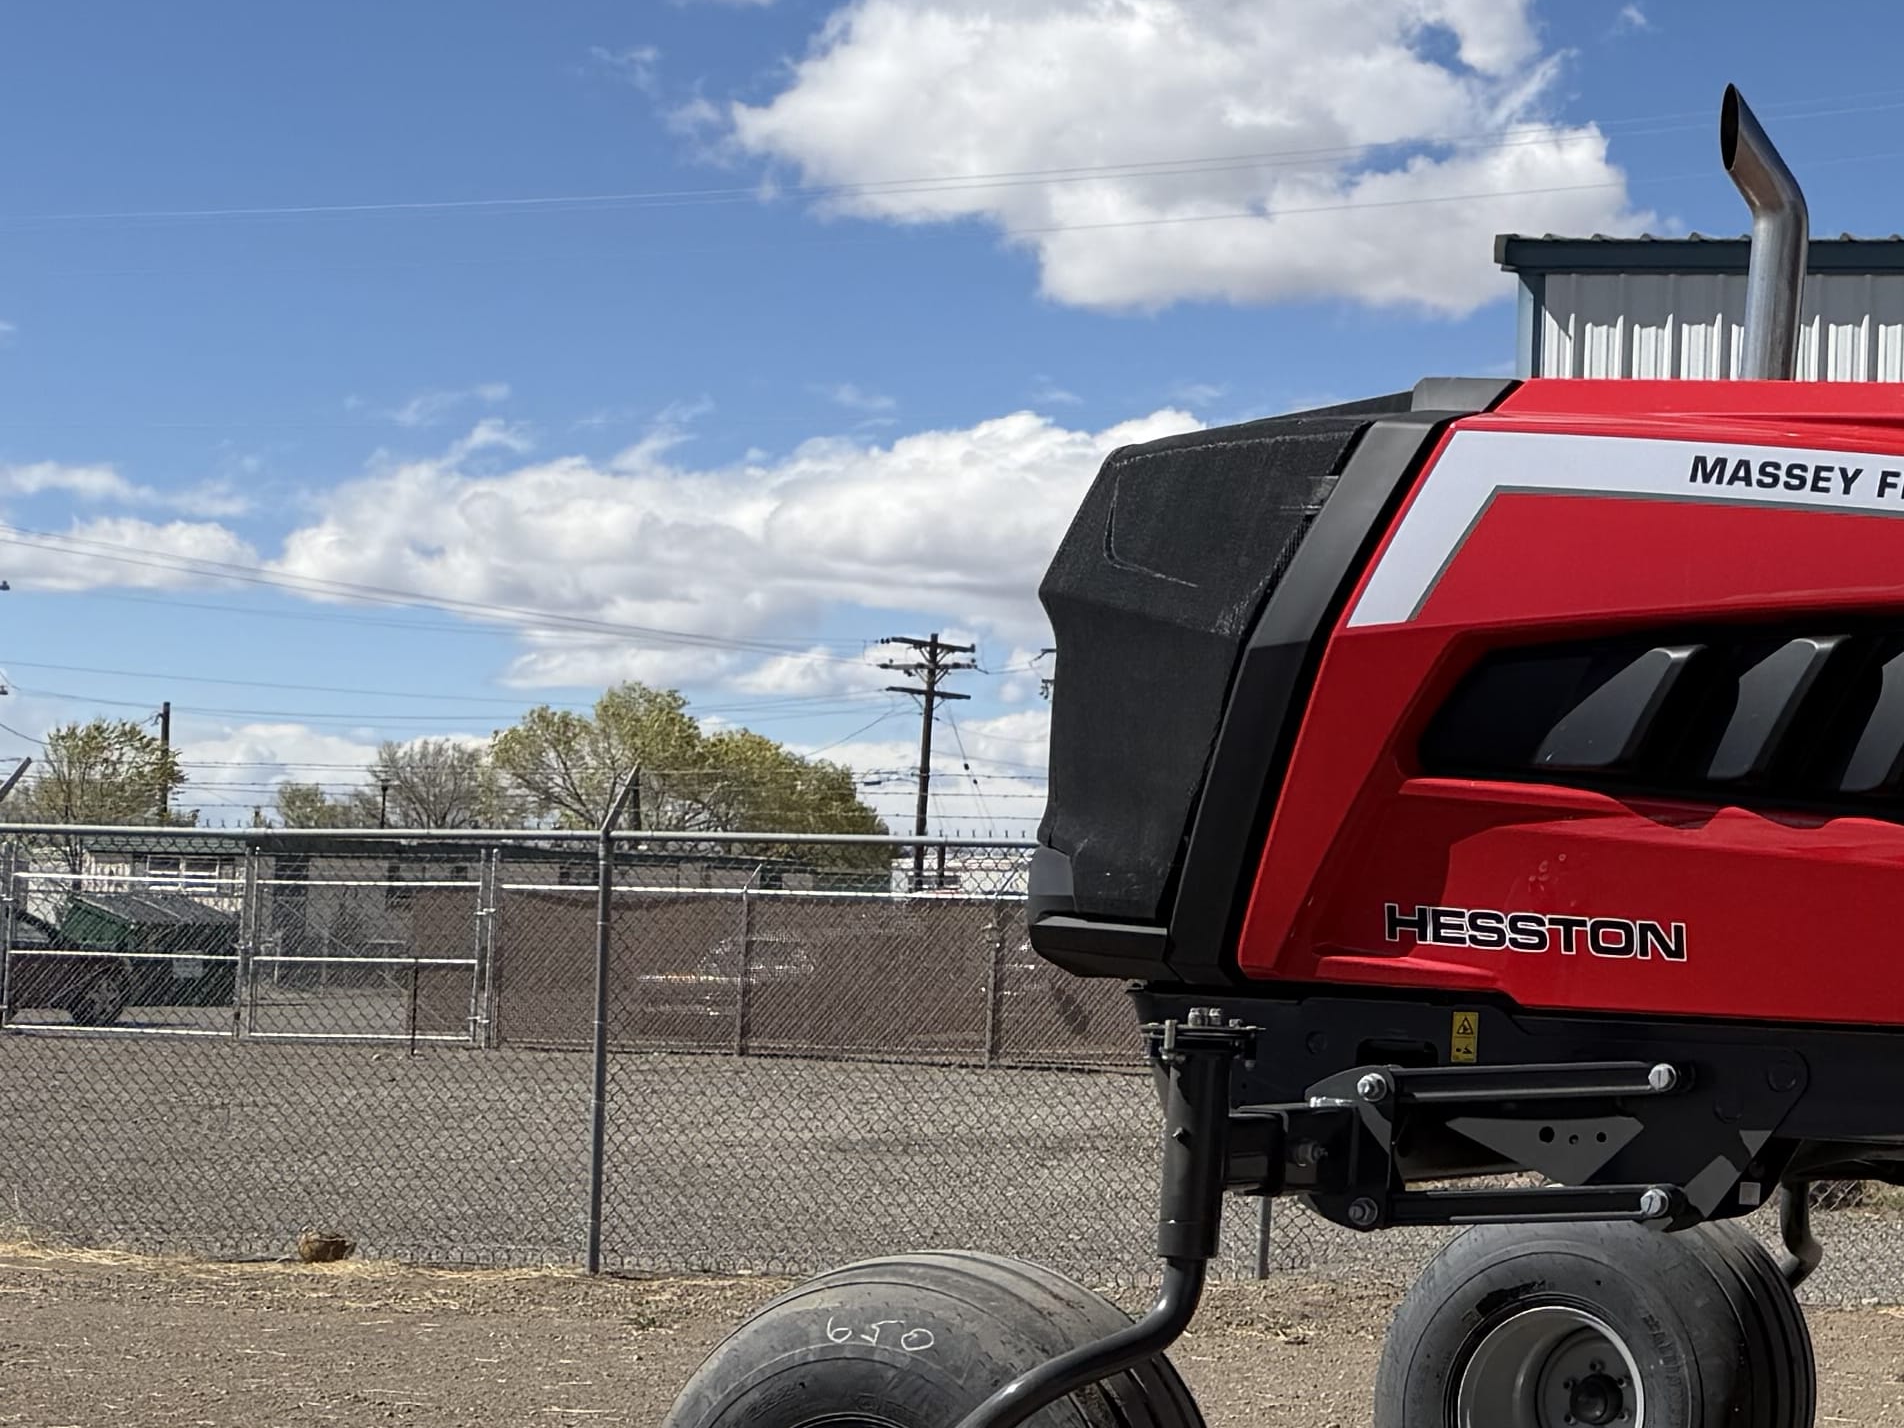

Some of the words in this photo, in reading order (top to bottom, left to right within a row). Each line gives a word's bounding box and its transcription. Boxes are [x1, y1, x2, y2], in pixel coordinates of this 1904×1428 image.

[1689, 454, 1863, 497] MASSEY
[1383, 902, 1687, 963] HESSTON
[824, 1315, 936, 1353] 650
